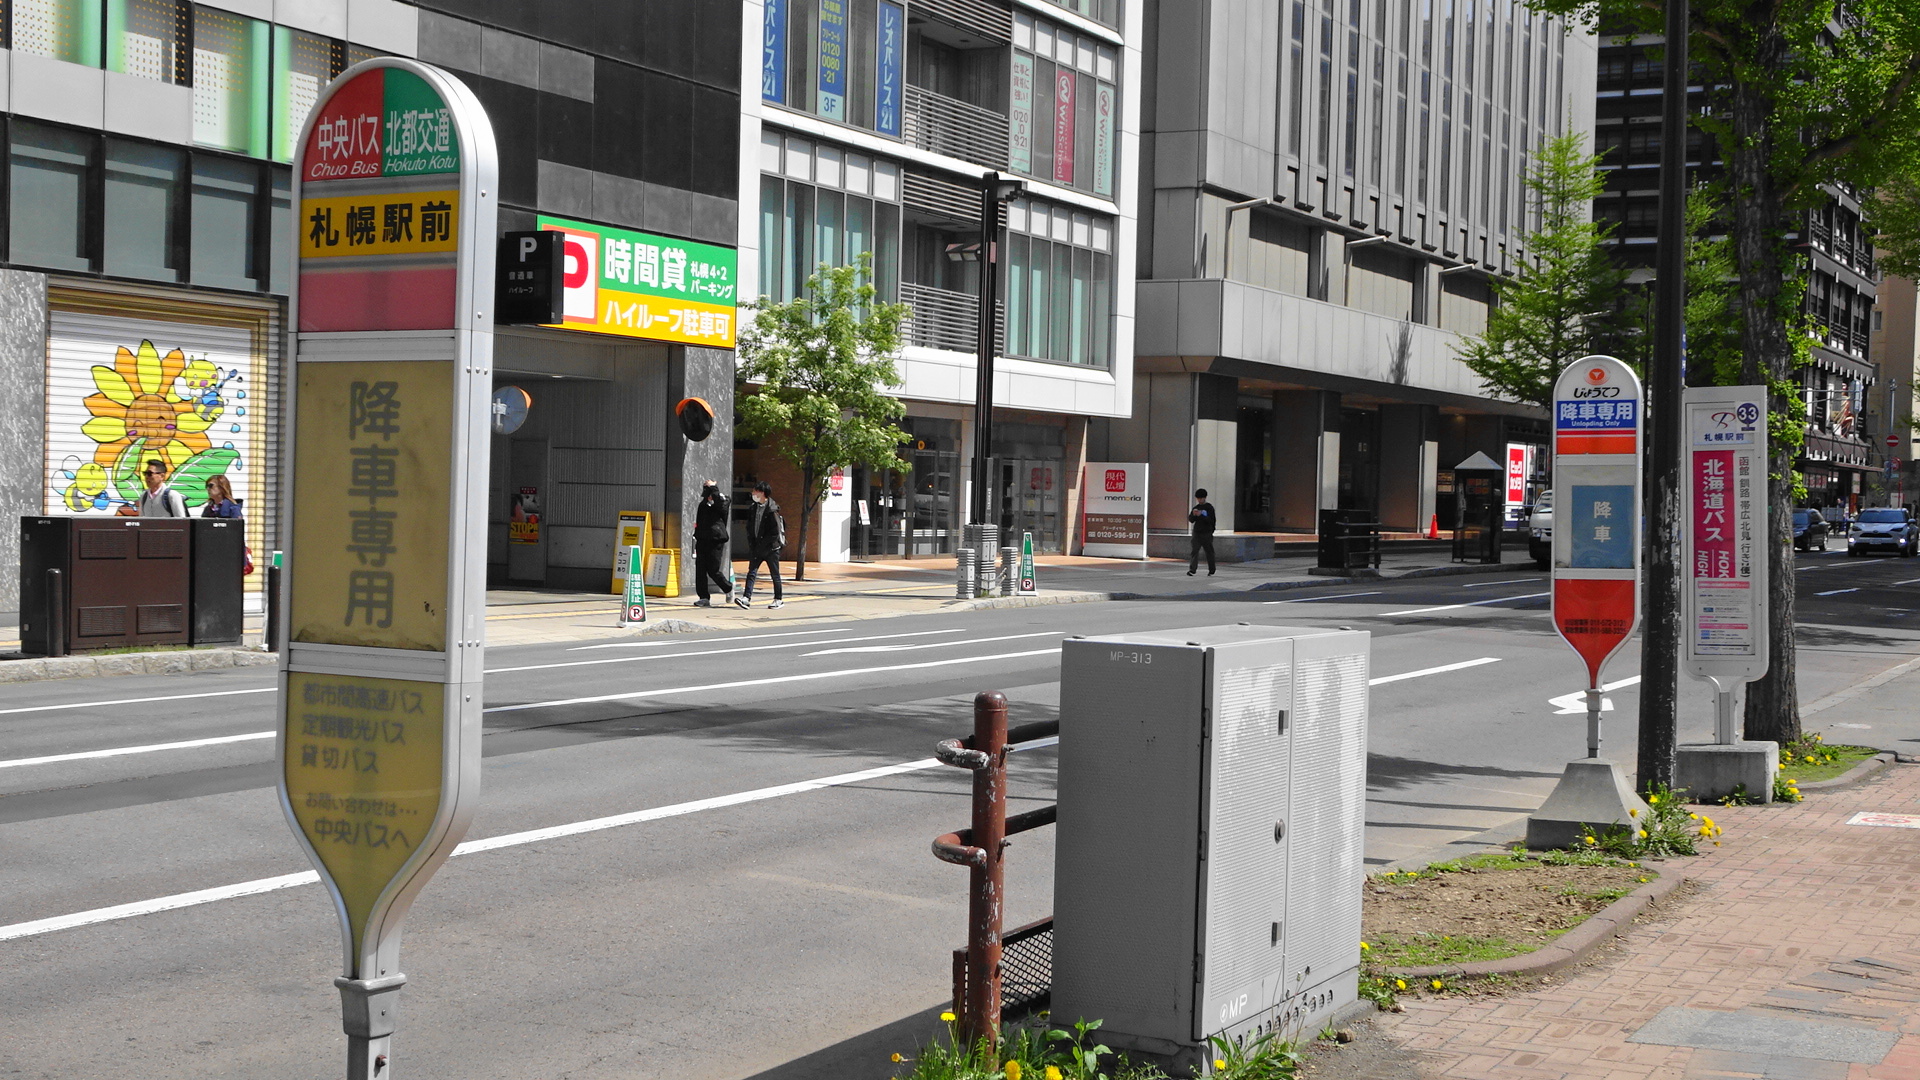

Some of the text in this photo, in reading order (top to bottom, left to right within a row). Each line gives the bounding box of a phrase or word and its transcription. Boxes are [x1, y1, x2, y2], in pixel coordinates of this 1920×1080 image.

[822, 40, 840, 57] 0120
[881, 8, 894, 130] レオパレス21
[823, 96, 836, 113] 3F
[318, 108, 450, 161] 中央バス 北都交通
[311, 160, 379, 178] Chuo Bus
[384, 154, 458, 173] Hokuto Kotu
[309, 200, 452, 249] 札幌駅前
[520, 236, 538, 263] P
[604, 237, 688, 293] 時間貸
[690, 279, 735, 299] パーキング
[604, 299, 731, 341] ハイルーフ駐車可
[1573, 386, 1621, 399] じょうてつ
[1560, 401, 1634, 421] 降車専用
[1738, 406, 1758, 421] 33
[1605, 420, 1621, 428] Only
[1703, 432, 1745, 442] 札幌駅前
[344, 380, 401, 629] 降車専用
[1104, 494, 1142, 502] memoria
[1702, 458, 1725, 543] 北海道バス
[1740, 500, 1751, 520] 帯広
[1593, 501, 1613, 543] 降車
[1740, 521, 1752, 541] 北見
[1697, 550, 1709, 578] HIGH
[1110, 650, 1152, 665] MP-313
[302, 713, 407, 746] 定期観光バス
[302, 743, 379, 774] 貸切バス
[314, 816, 410, 849] 中央バスへ
[1229, 993, 1248, 1019] MP
